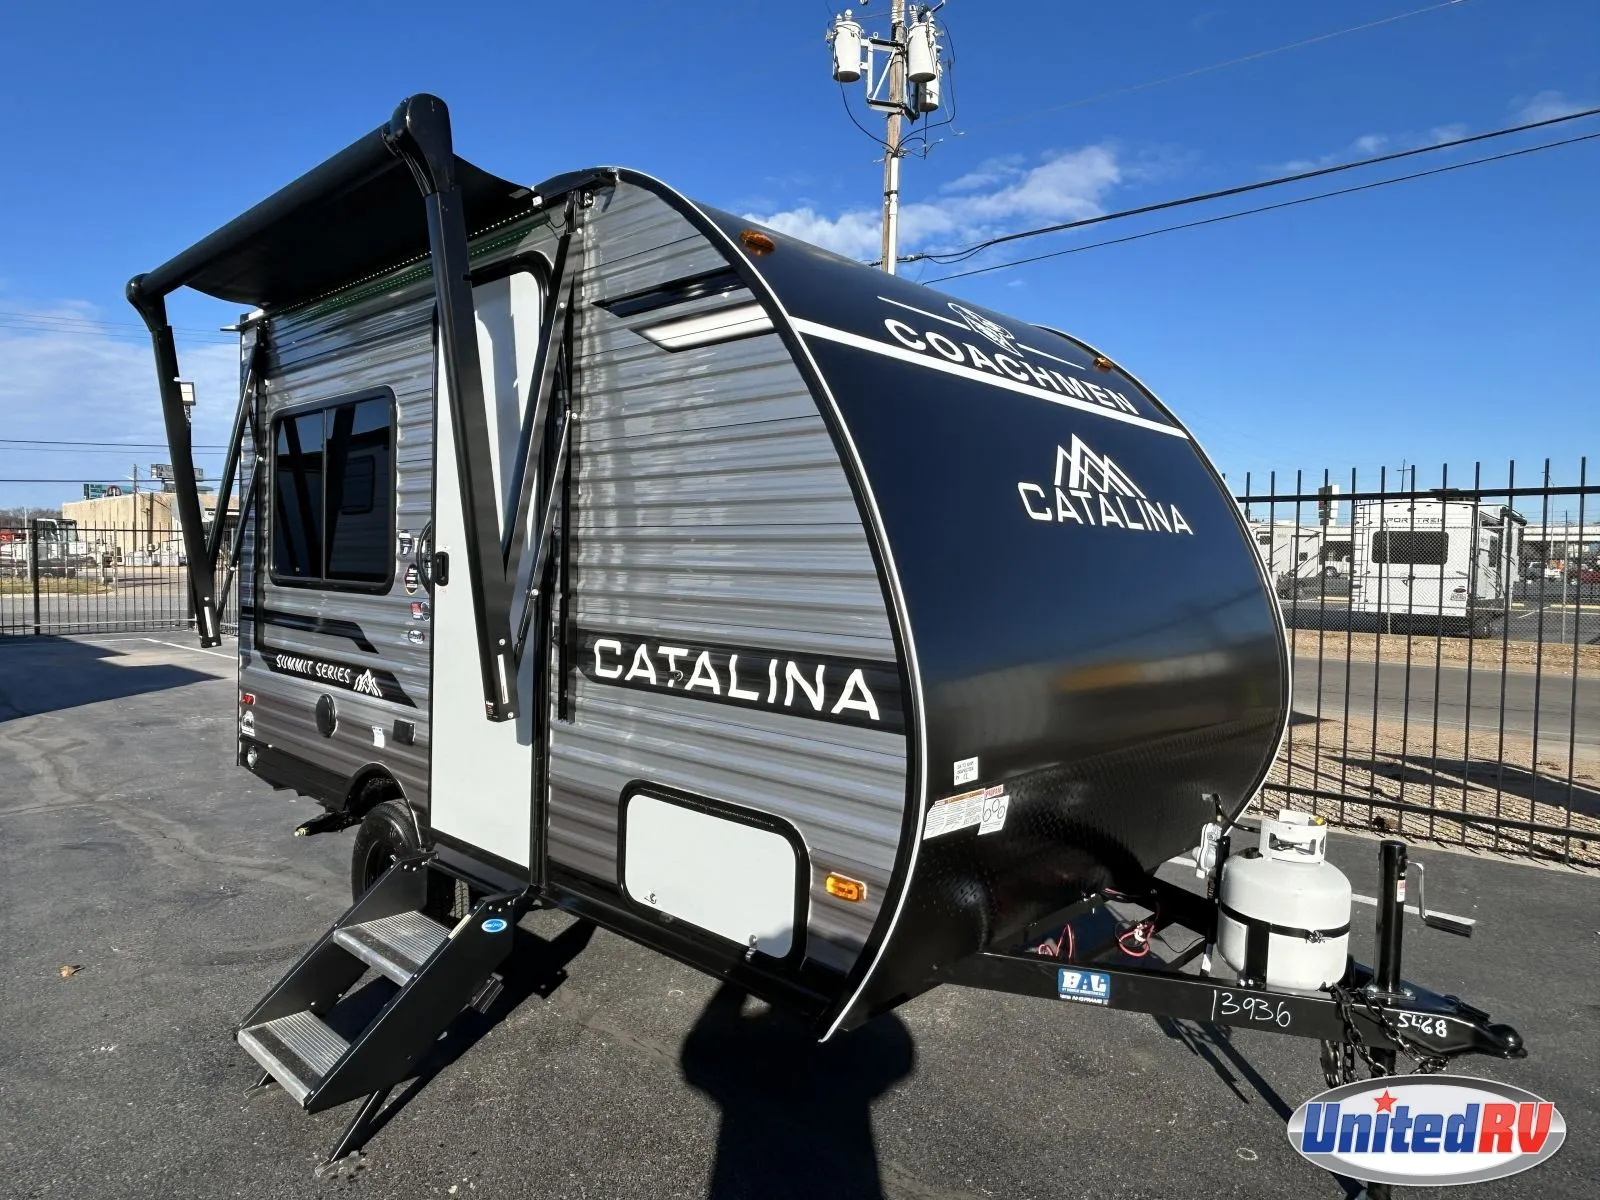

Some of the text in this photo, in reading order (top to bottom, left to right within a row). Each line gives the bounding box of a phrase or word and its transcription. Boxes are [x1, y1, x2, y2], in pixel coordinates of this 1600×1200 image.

[884, 318, 1140, 416] COACHMEN
[1017, 481, 1194, 535] CATALINA
[276, 654, 351, 684] SUMMIT SERIES
[593, 638, 880, 721] CATALINA
[1211, 989, 1291, 1028] 13936
[1397, 1012, 1448, 1038] 5468
